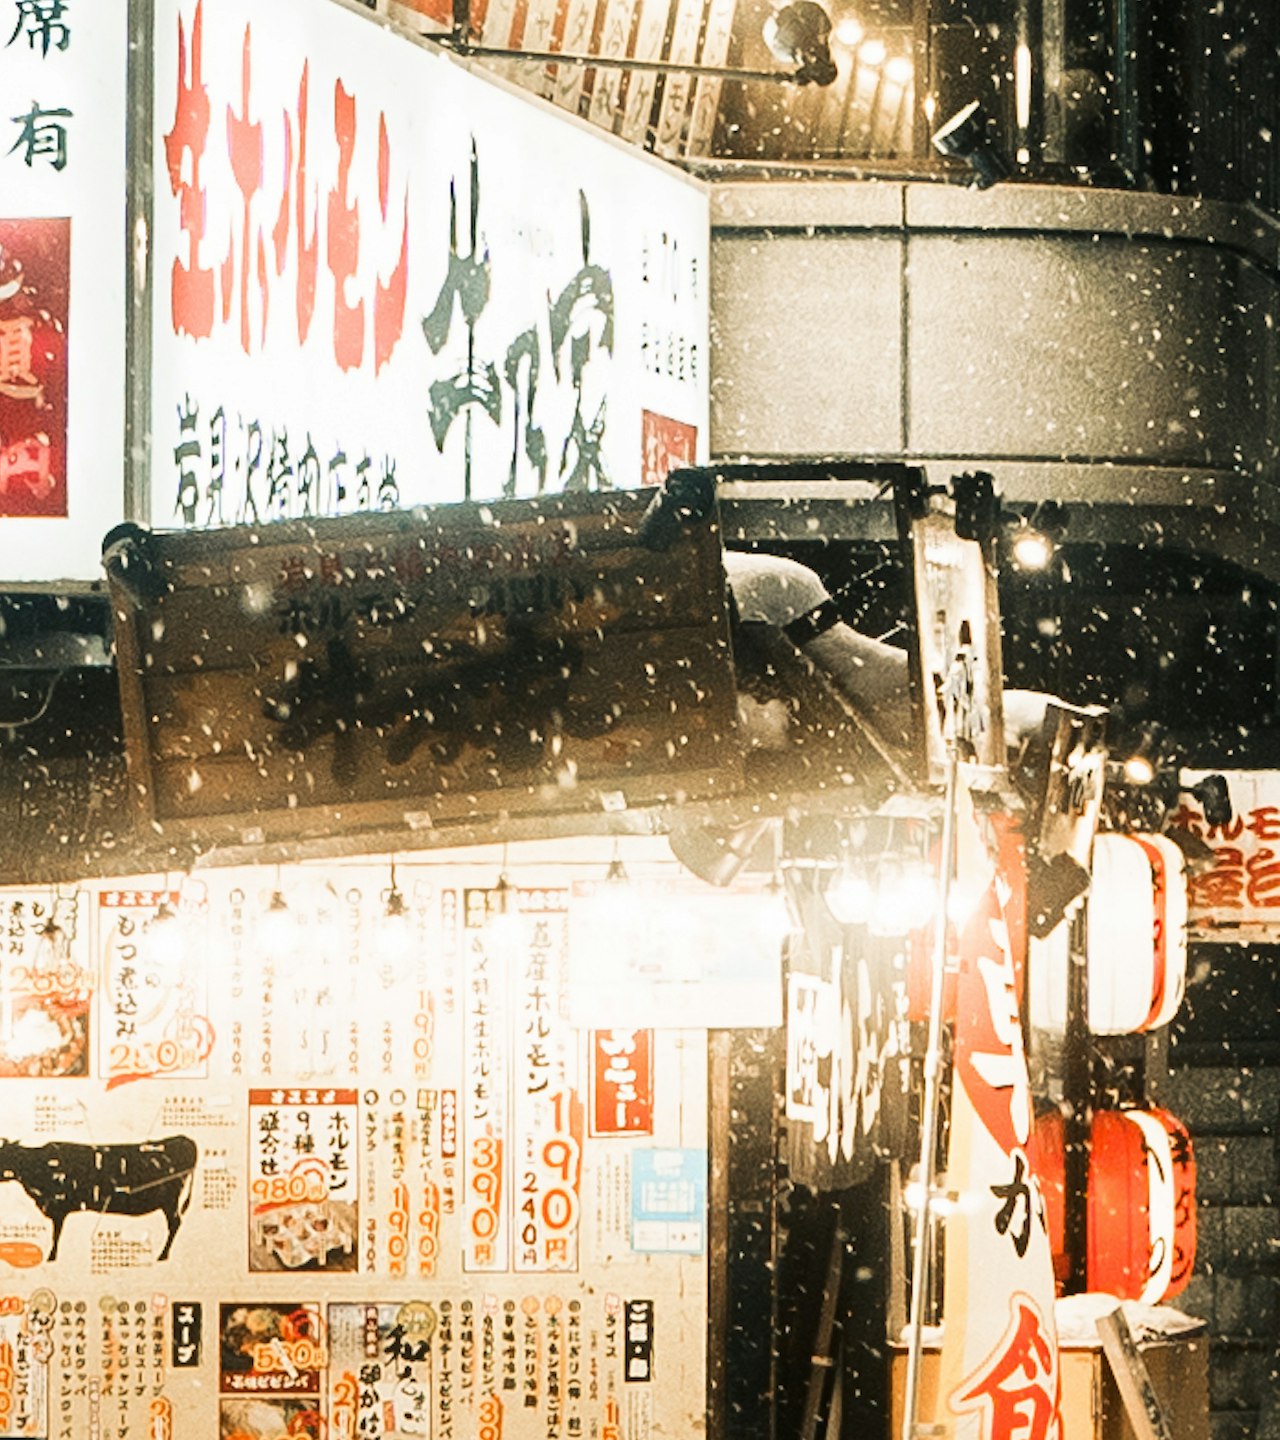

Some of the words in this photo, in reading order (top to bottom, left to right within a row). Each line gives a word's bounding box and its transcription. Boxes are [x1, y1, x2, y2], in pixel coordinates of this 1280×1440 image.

[116, 914, 139, 1040] もつ煮込み
[327, 1110, 352, 1194] ホルモン
[541, 1088, 574, 1265] 190円
[470, 1138, 497, 1263] 390円
[134, 1316, 147, 1397] カルビスープ
[177, 1304, 197, 1365] スープ
[604, 1315, 617, 1359] ライス
